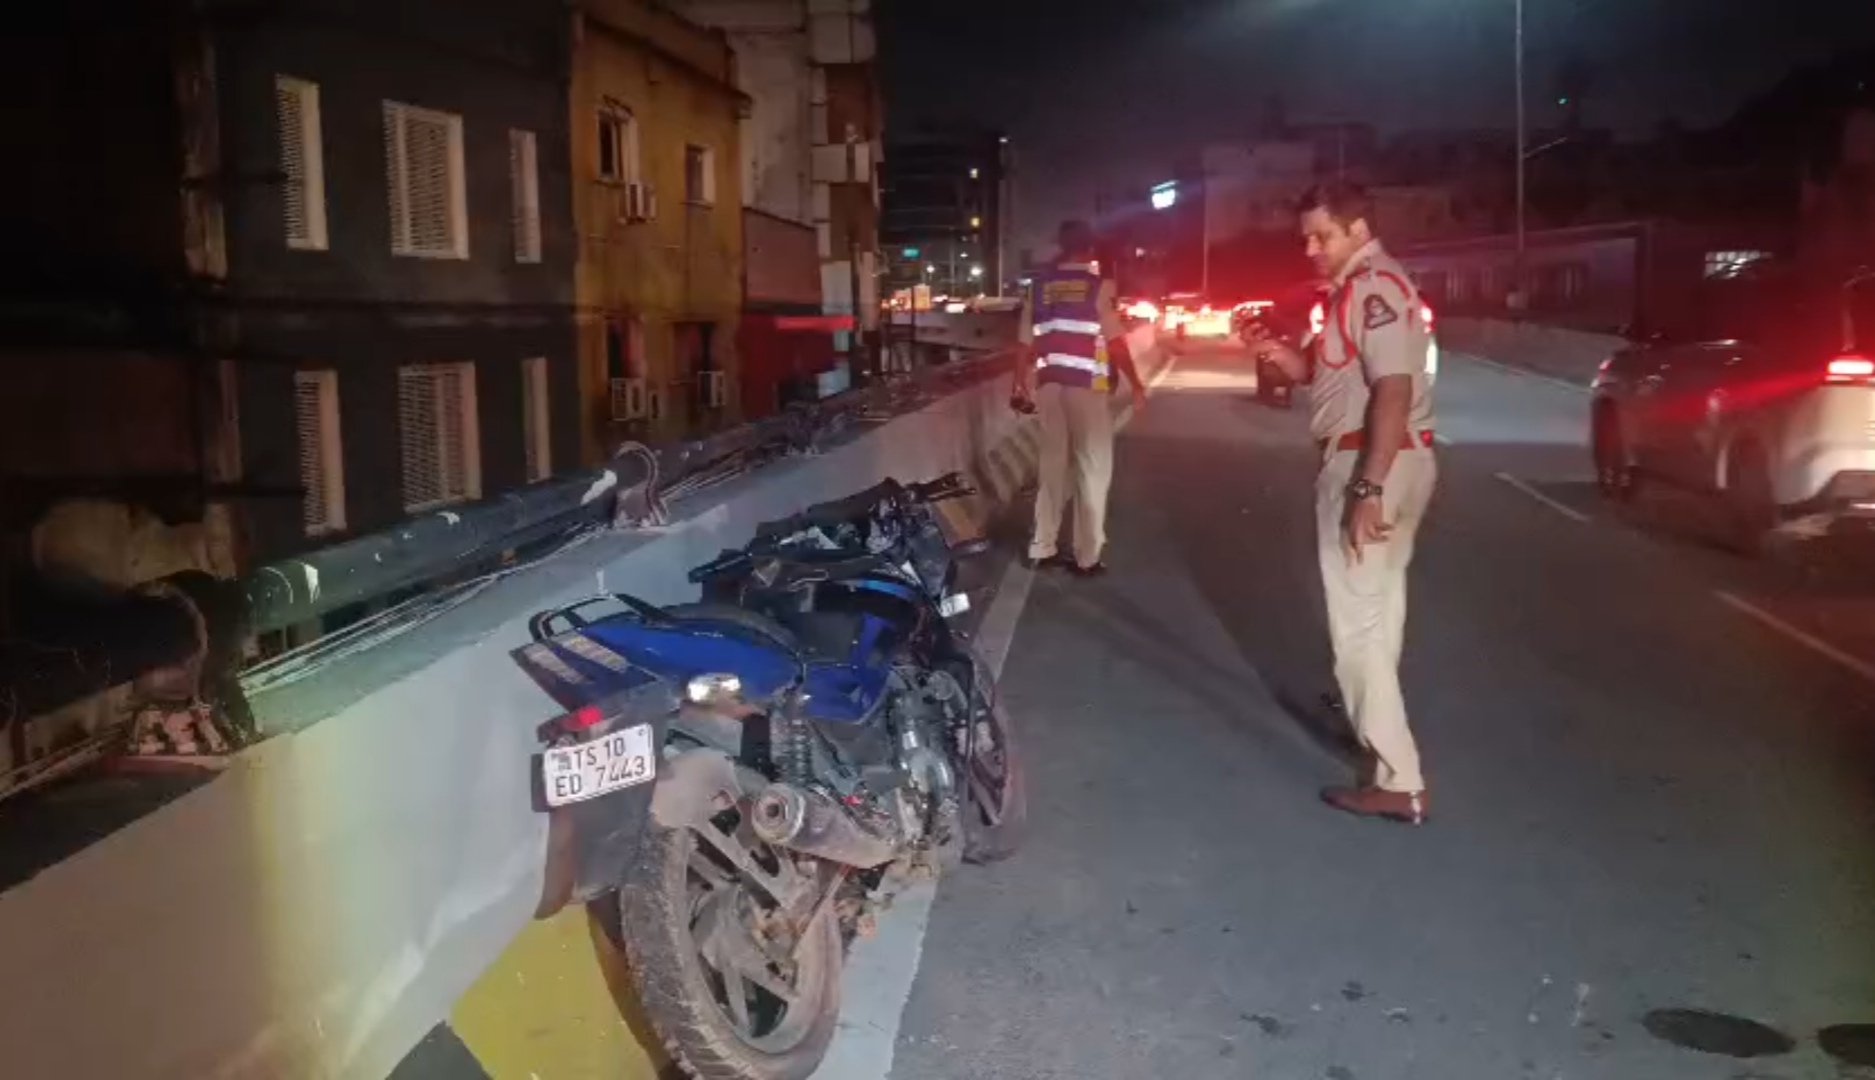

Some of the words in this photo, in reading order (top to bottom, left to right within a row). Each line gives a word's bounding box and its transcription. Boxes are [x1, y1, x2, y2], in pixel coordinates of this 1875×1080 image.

[573, 746, 597, 770] TS
[603, 737, 625, 760] 10
[556, 773, 582, 797] ED
[596, 755, 646, 788] 7443
